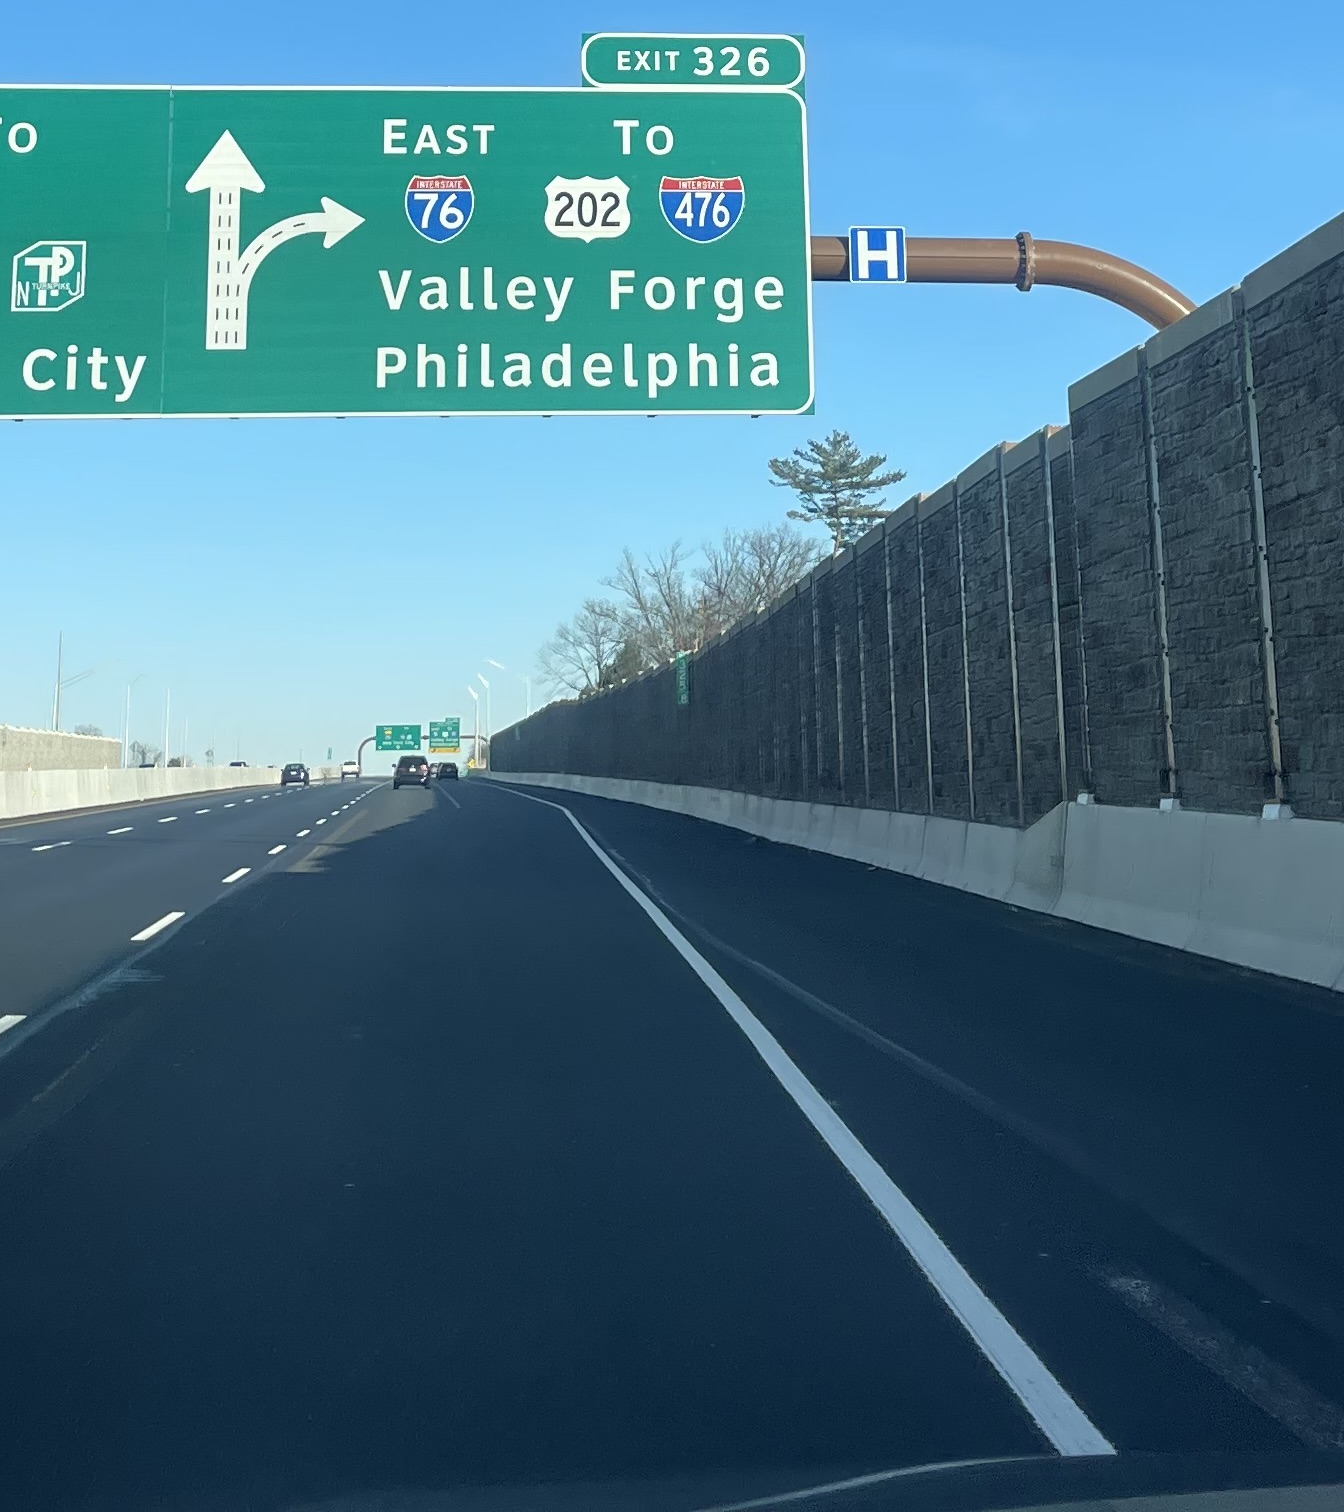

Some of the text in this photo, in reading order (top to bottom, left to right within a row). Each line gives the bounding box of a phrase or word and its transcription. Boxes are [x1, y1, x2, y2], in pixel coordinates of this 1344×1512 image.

[617, 46, 770, 77] EXIT 326
[383, 118, 495, 155] EAST
[417, 180, 462, 190] INTERSTATE
[678, 180, 725, 190] INTERSTATE
[414, 192, 464, 230] 76
[554, 191, 621, 228] 202
[674, 192, 731, 228] 476
[857, 230, 899, 279] H
[378, 266, 784, 323] Valley Forge
[22, 344, 147, 403] City
[376, 342, 780, 399] Philadelphia
